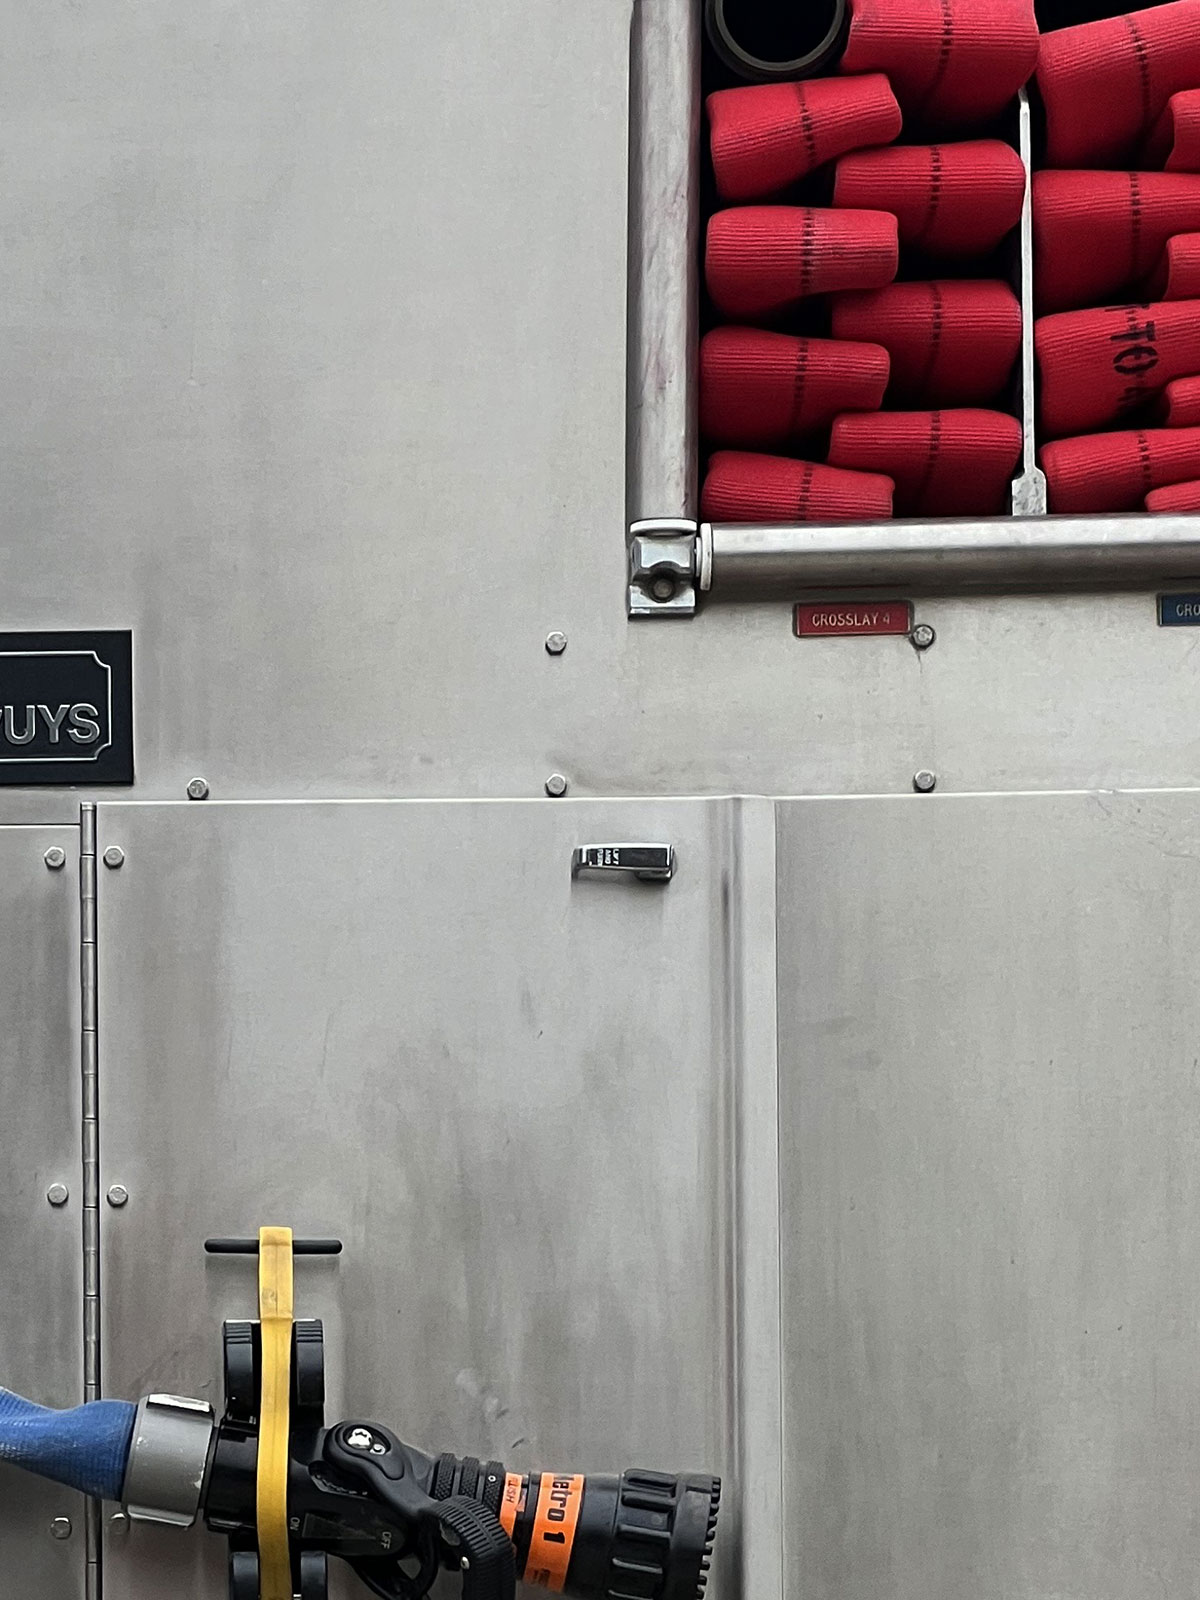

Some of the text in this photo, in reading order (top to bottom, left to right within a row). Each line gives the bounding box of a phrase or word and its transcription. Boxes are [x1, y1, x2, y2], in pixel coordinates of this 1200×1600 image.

[812, 612, 890, 627] CROSSLAY 4
[289, 1516, 300, 1531] ON
[380, 1531, 392, 1549] OFF
[543, 1531, 566, 1544] 1
